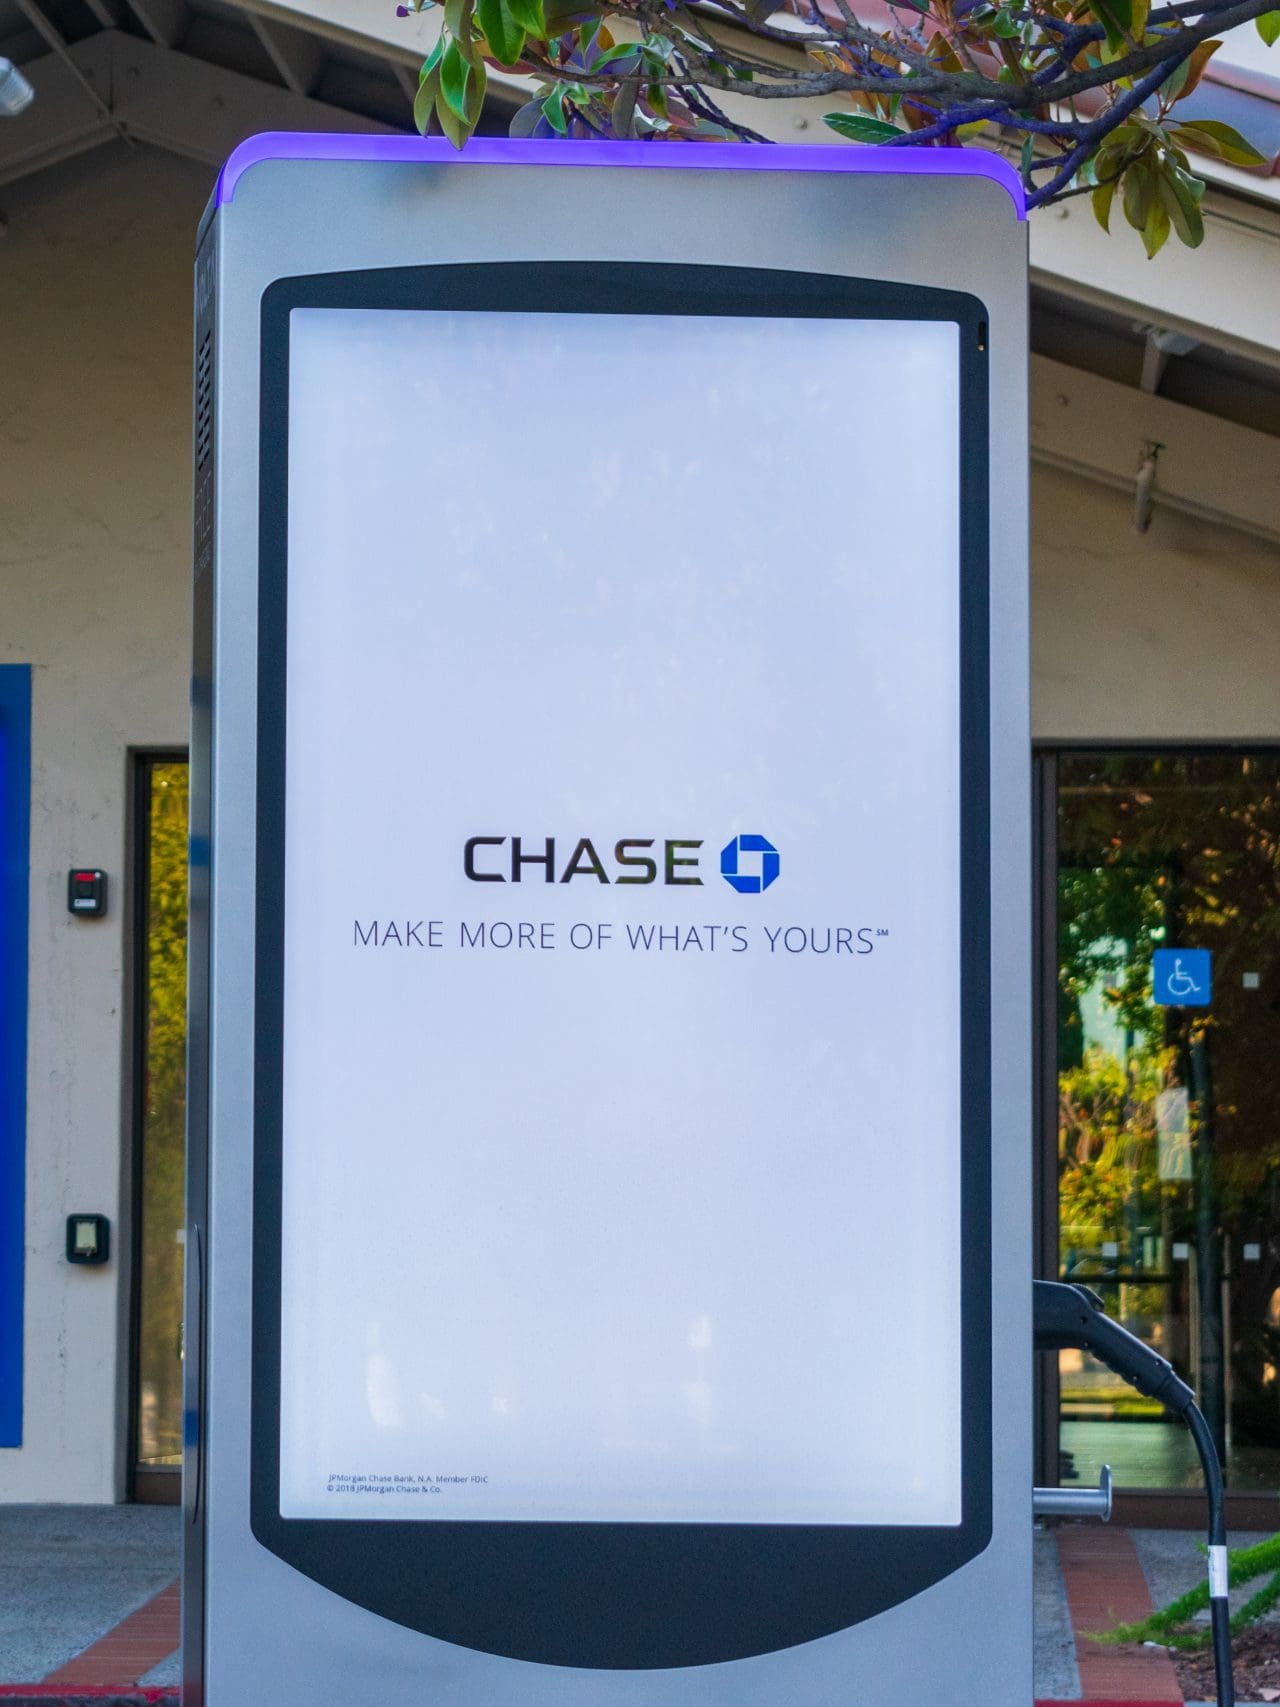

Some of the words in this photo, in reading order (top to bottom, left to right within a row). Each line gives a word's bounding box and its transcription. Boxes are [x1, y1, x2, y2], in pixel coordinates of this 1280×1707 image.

[464, 836, 704, 886] CHASE
[353, 919, 444, 948] MAKE
[460, 921, 556, 950] MORE
[569, 923, 613, 950] OF
[626, 923, 749, 953] WHAT’S
[328, 1474, 367, 1484] JPMorgan
[369, 1474, 393, 1483] Chase
[394, 1475, 416, 1484] Bank,
[436, 1475, 469, 1484] Member
[471, 1475, 489, 1484] FDIC
[336, 1484, 355, 1492] 2018
[356, 1484, 395, 1495] JPMorgan
[396, 1485, 420, 1493] Chase
